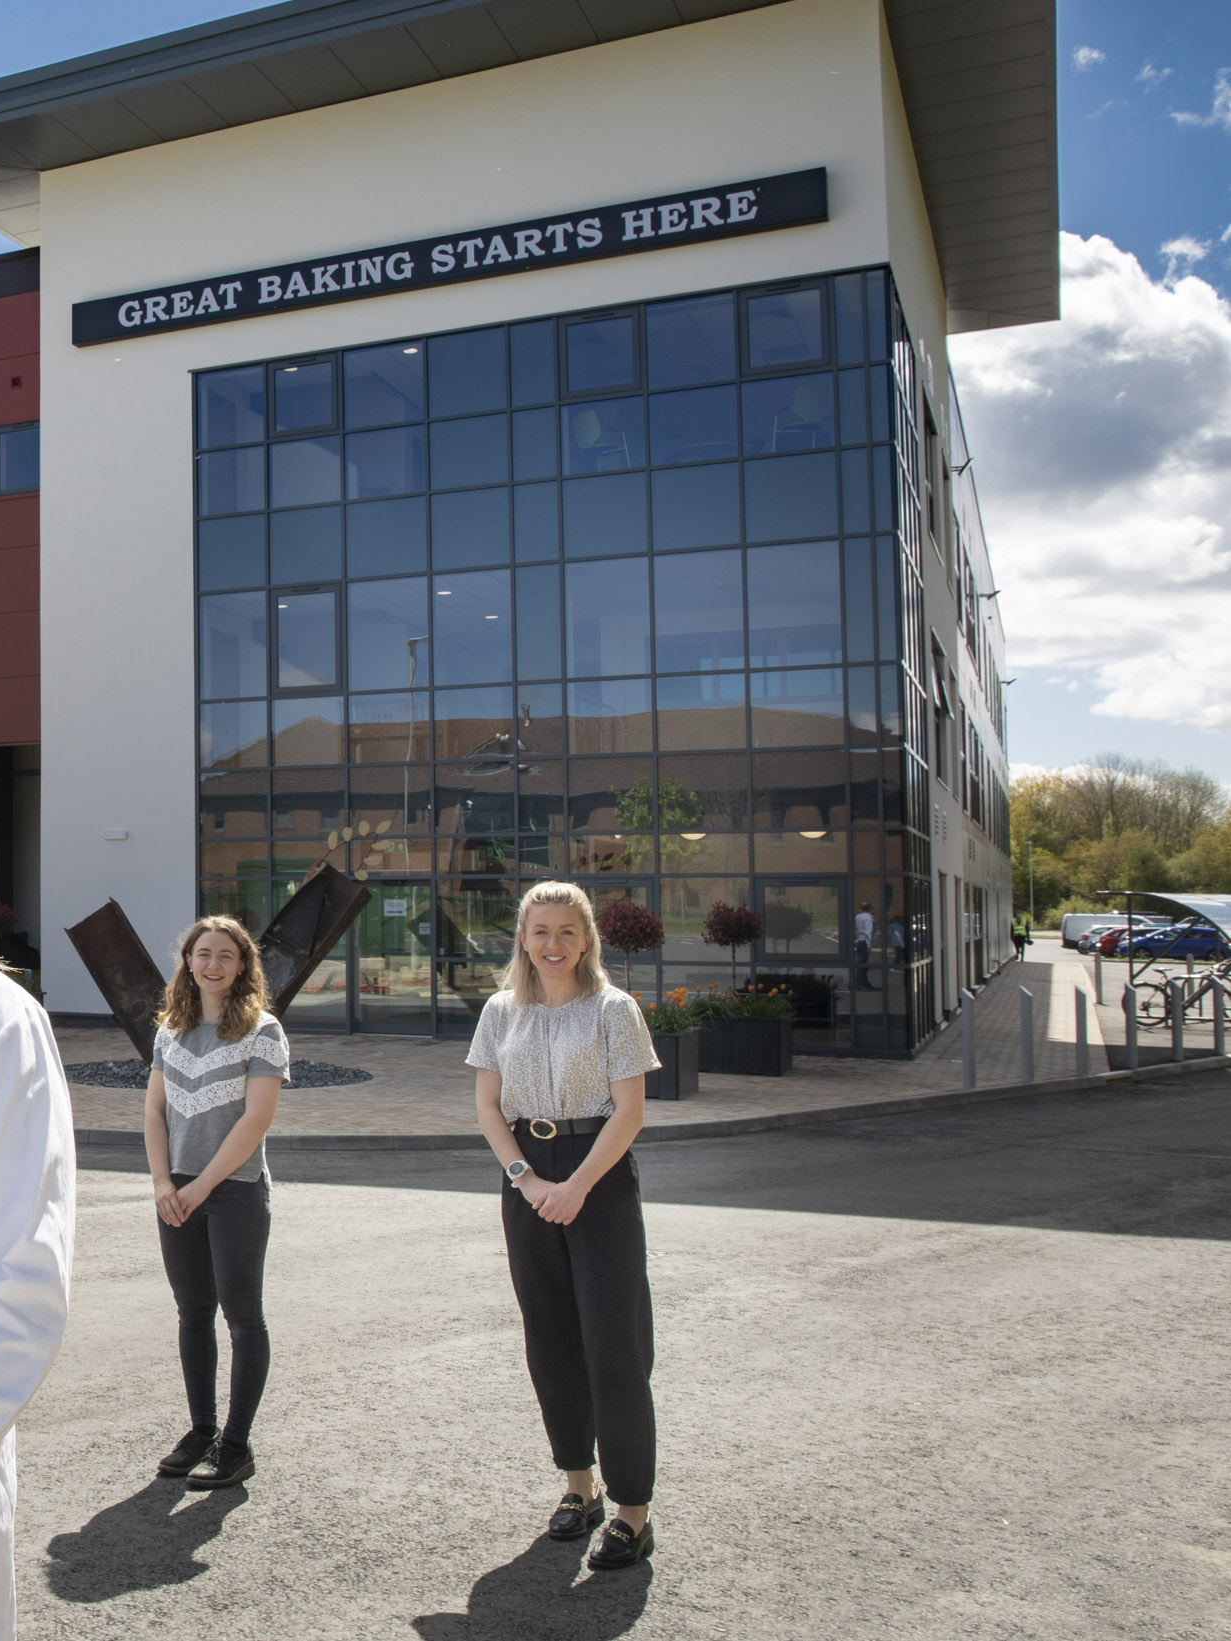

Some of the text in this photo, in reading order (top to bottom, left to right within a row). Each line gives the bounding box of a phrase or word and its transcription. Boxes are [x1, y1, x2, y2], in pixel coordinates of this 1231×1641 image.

[118, 190, 758, 327] GREAT BAKING STARTS HERE
